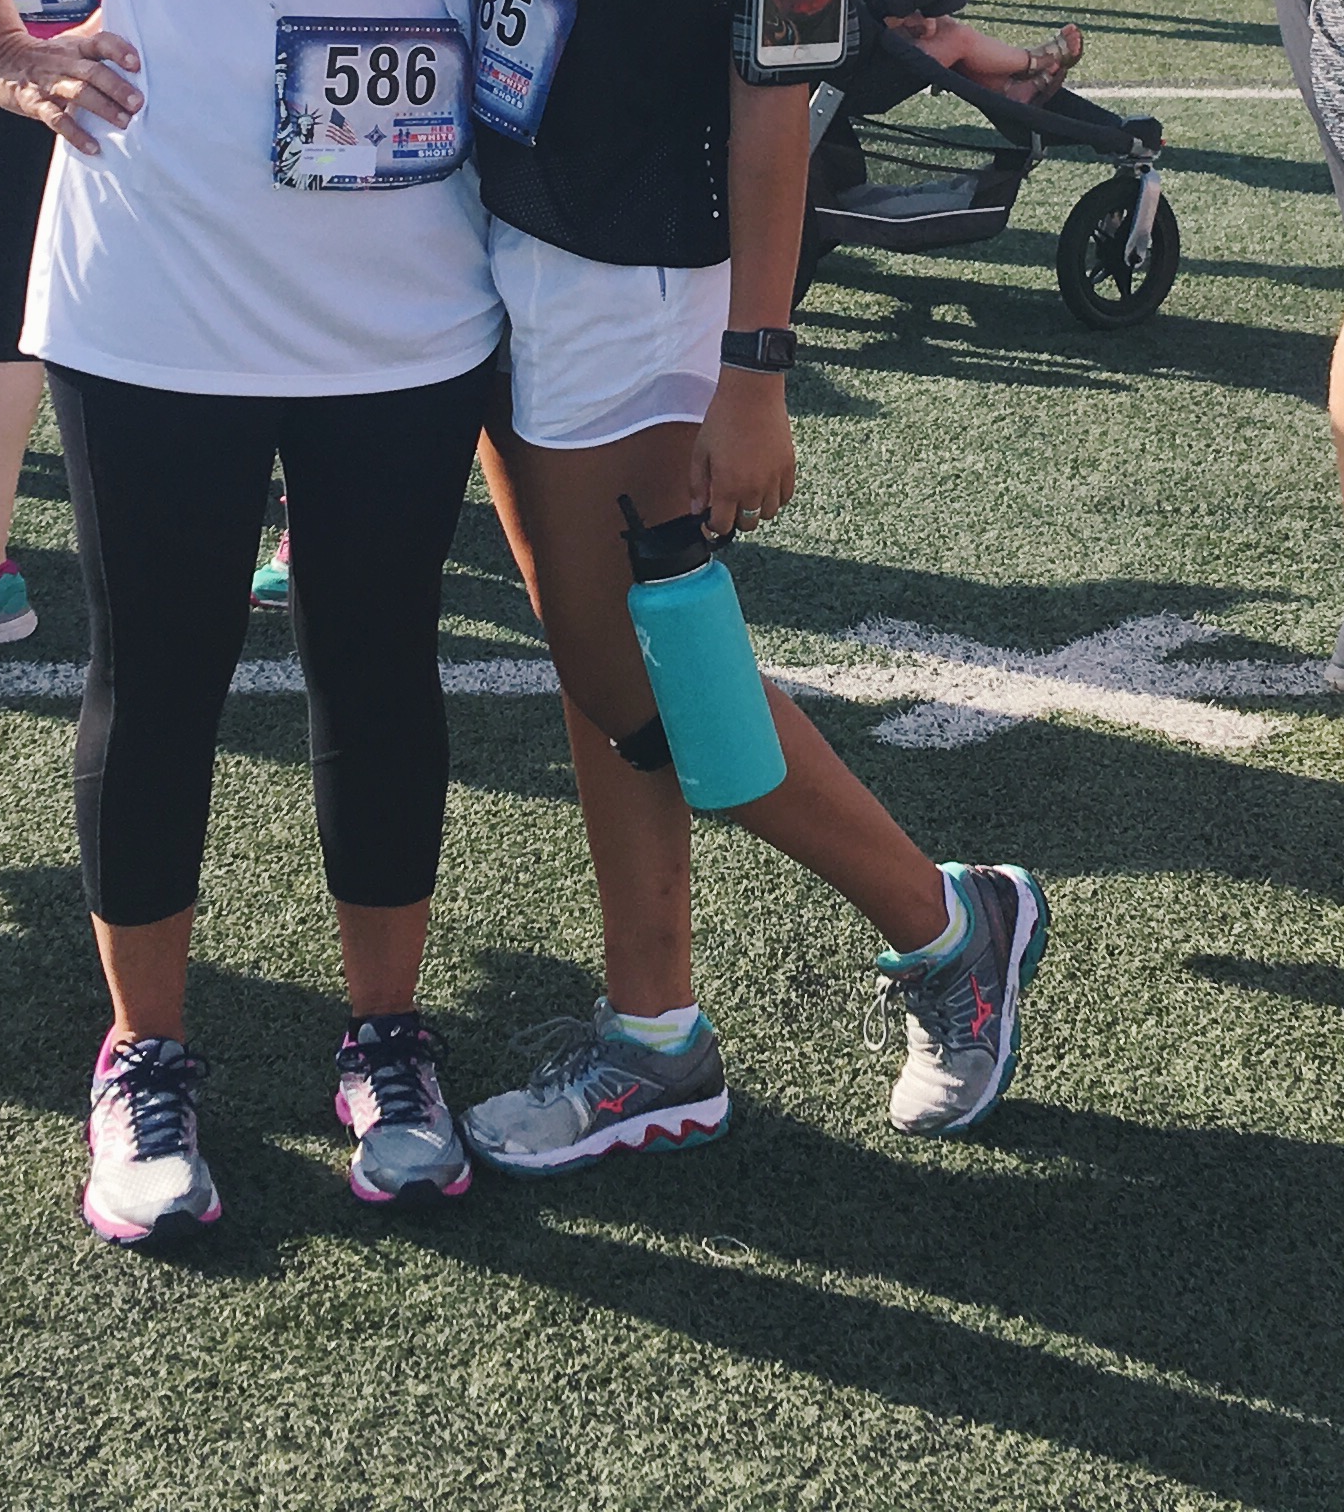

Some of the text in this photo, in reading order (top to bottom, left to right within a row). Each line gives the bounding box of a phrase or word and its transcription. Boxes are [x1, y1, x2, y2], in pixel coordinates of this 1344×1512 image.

[324, 45, 437, 106] 586
[417, 133, 454, 142] WHITE
[418, 148, 454, 158] SHOES
